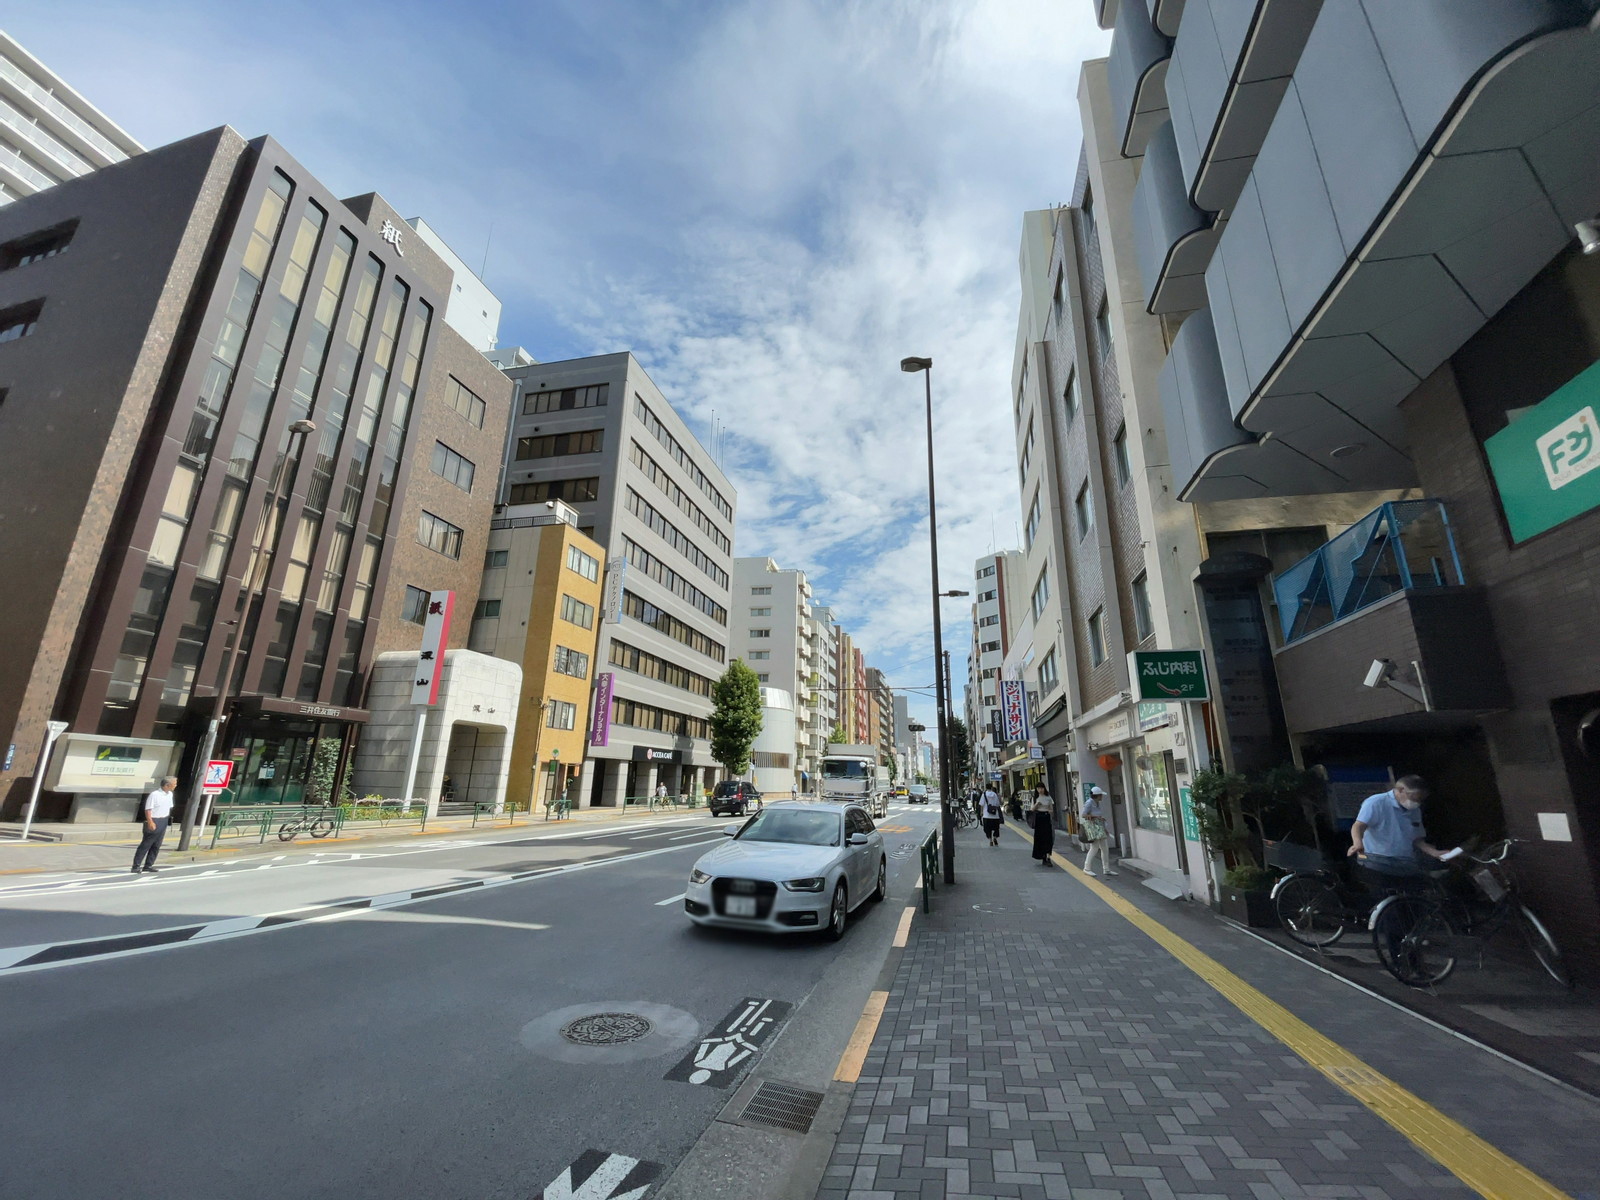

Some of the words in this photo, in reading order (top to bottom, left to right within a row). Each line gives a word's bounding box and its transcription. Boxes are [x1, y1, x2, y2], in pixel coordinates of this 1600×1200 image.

[1143, 661, 1198, 676] ふじ内科
[1181, 684, 1195, 692] 2F
[299, 705, 341, 717] 三井住友銀行
[1007, 683, 1021, 736] ジョナサン
